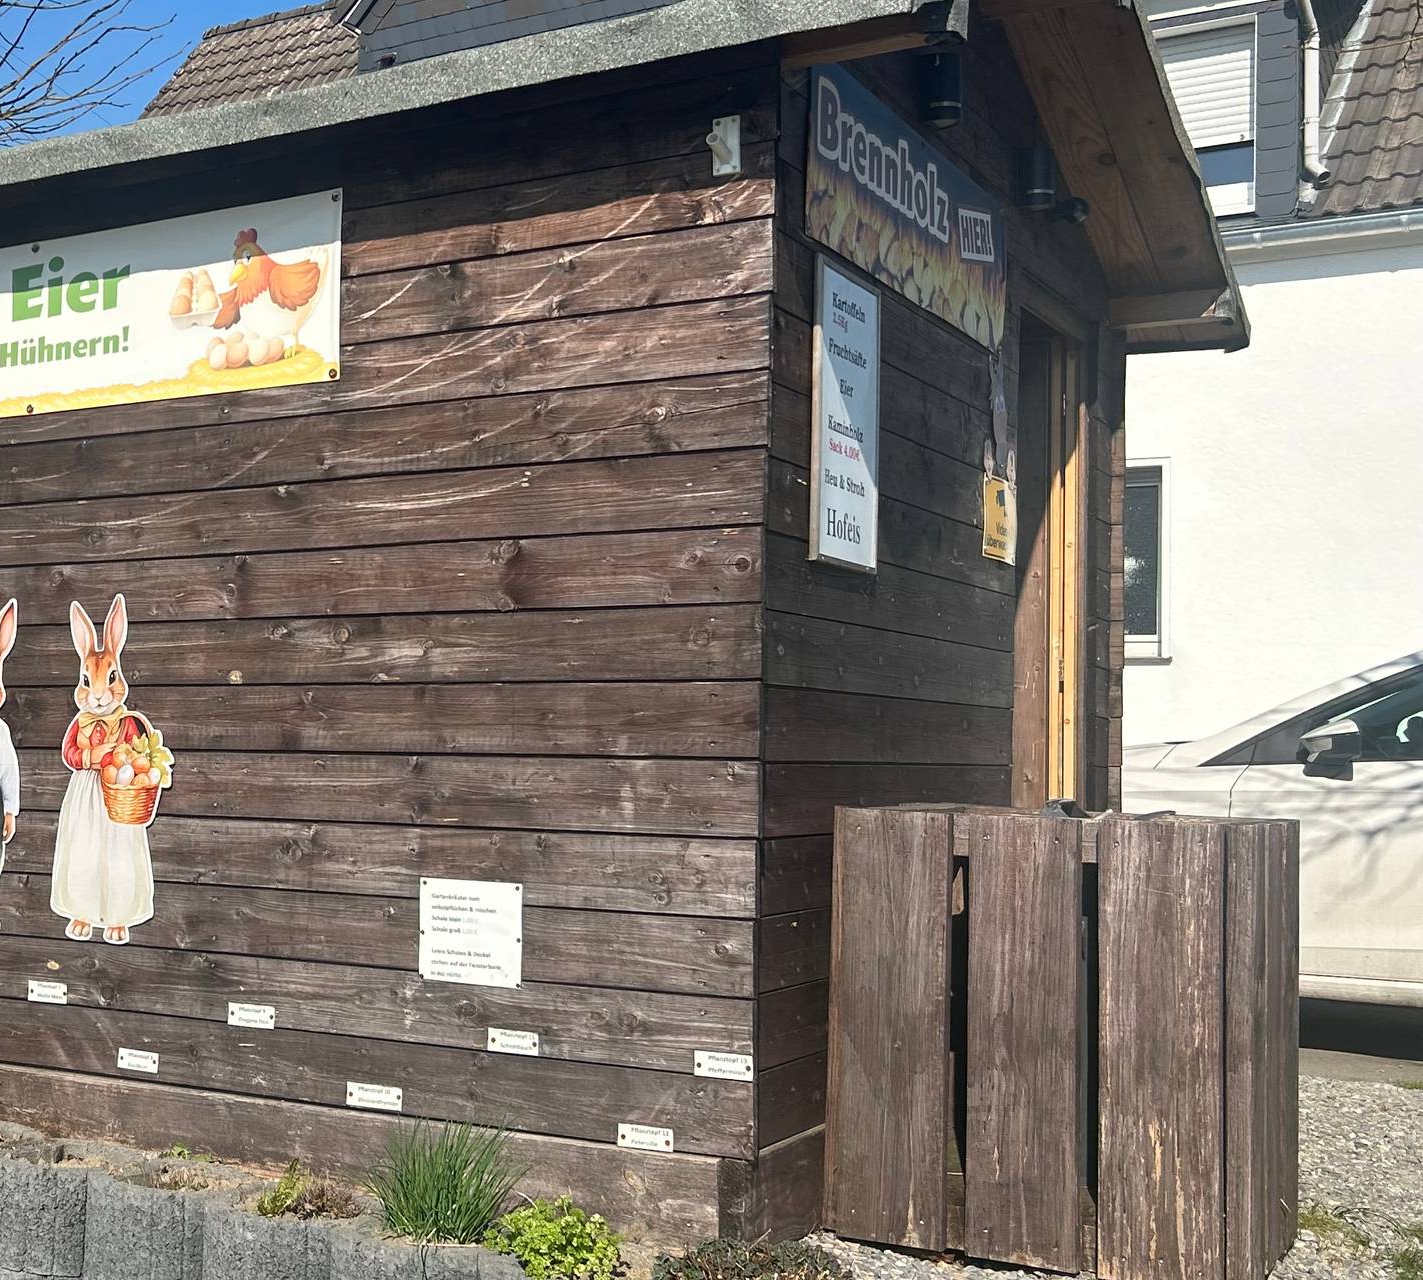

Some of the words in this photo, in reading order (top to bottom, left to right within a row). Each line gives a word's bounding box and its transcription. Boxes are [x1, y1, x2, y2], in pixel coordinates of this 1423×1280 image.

[817, 76, 949, 243] Brennholz
[960, 212, 994, 258] HIER!
[12, 256, 130, 322] Eier
[832, 292, 866, 325] Kartoffeln
[0, 325, 129, 368] Hühnern!
[829, 337, 867, 370] Fruchtsäfte
[839, 378, 854, 398] Eier
[828, 414, 863, 443] Kaminholz
[829, 437, 843, 455] Sack
[824, 468, 838, 487] Heu
[839, 474, 846, 490] &
[846, 477, 865, 497] Stroh
[826, 507, 861, 545] Hofeis
